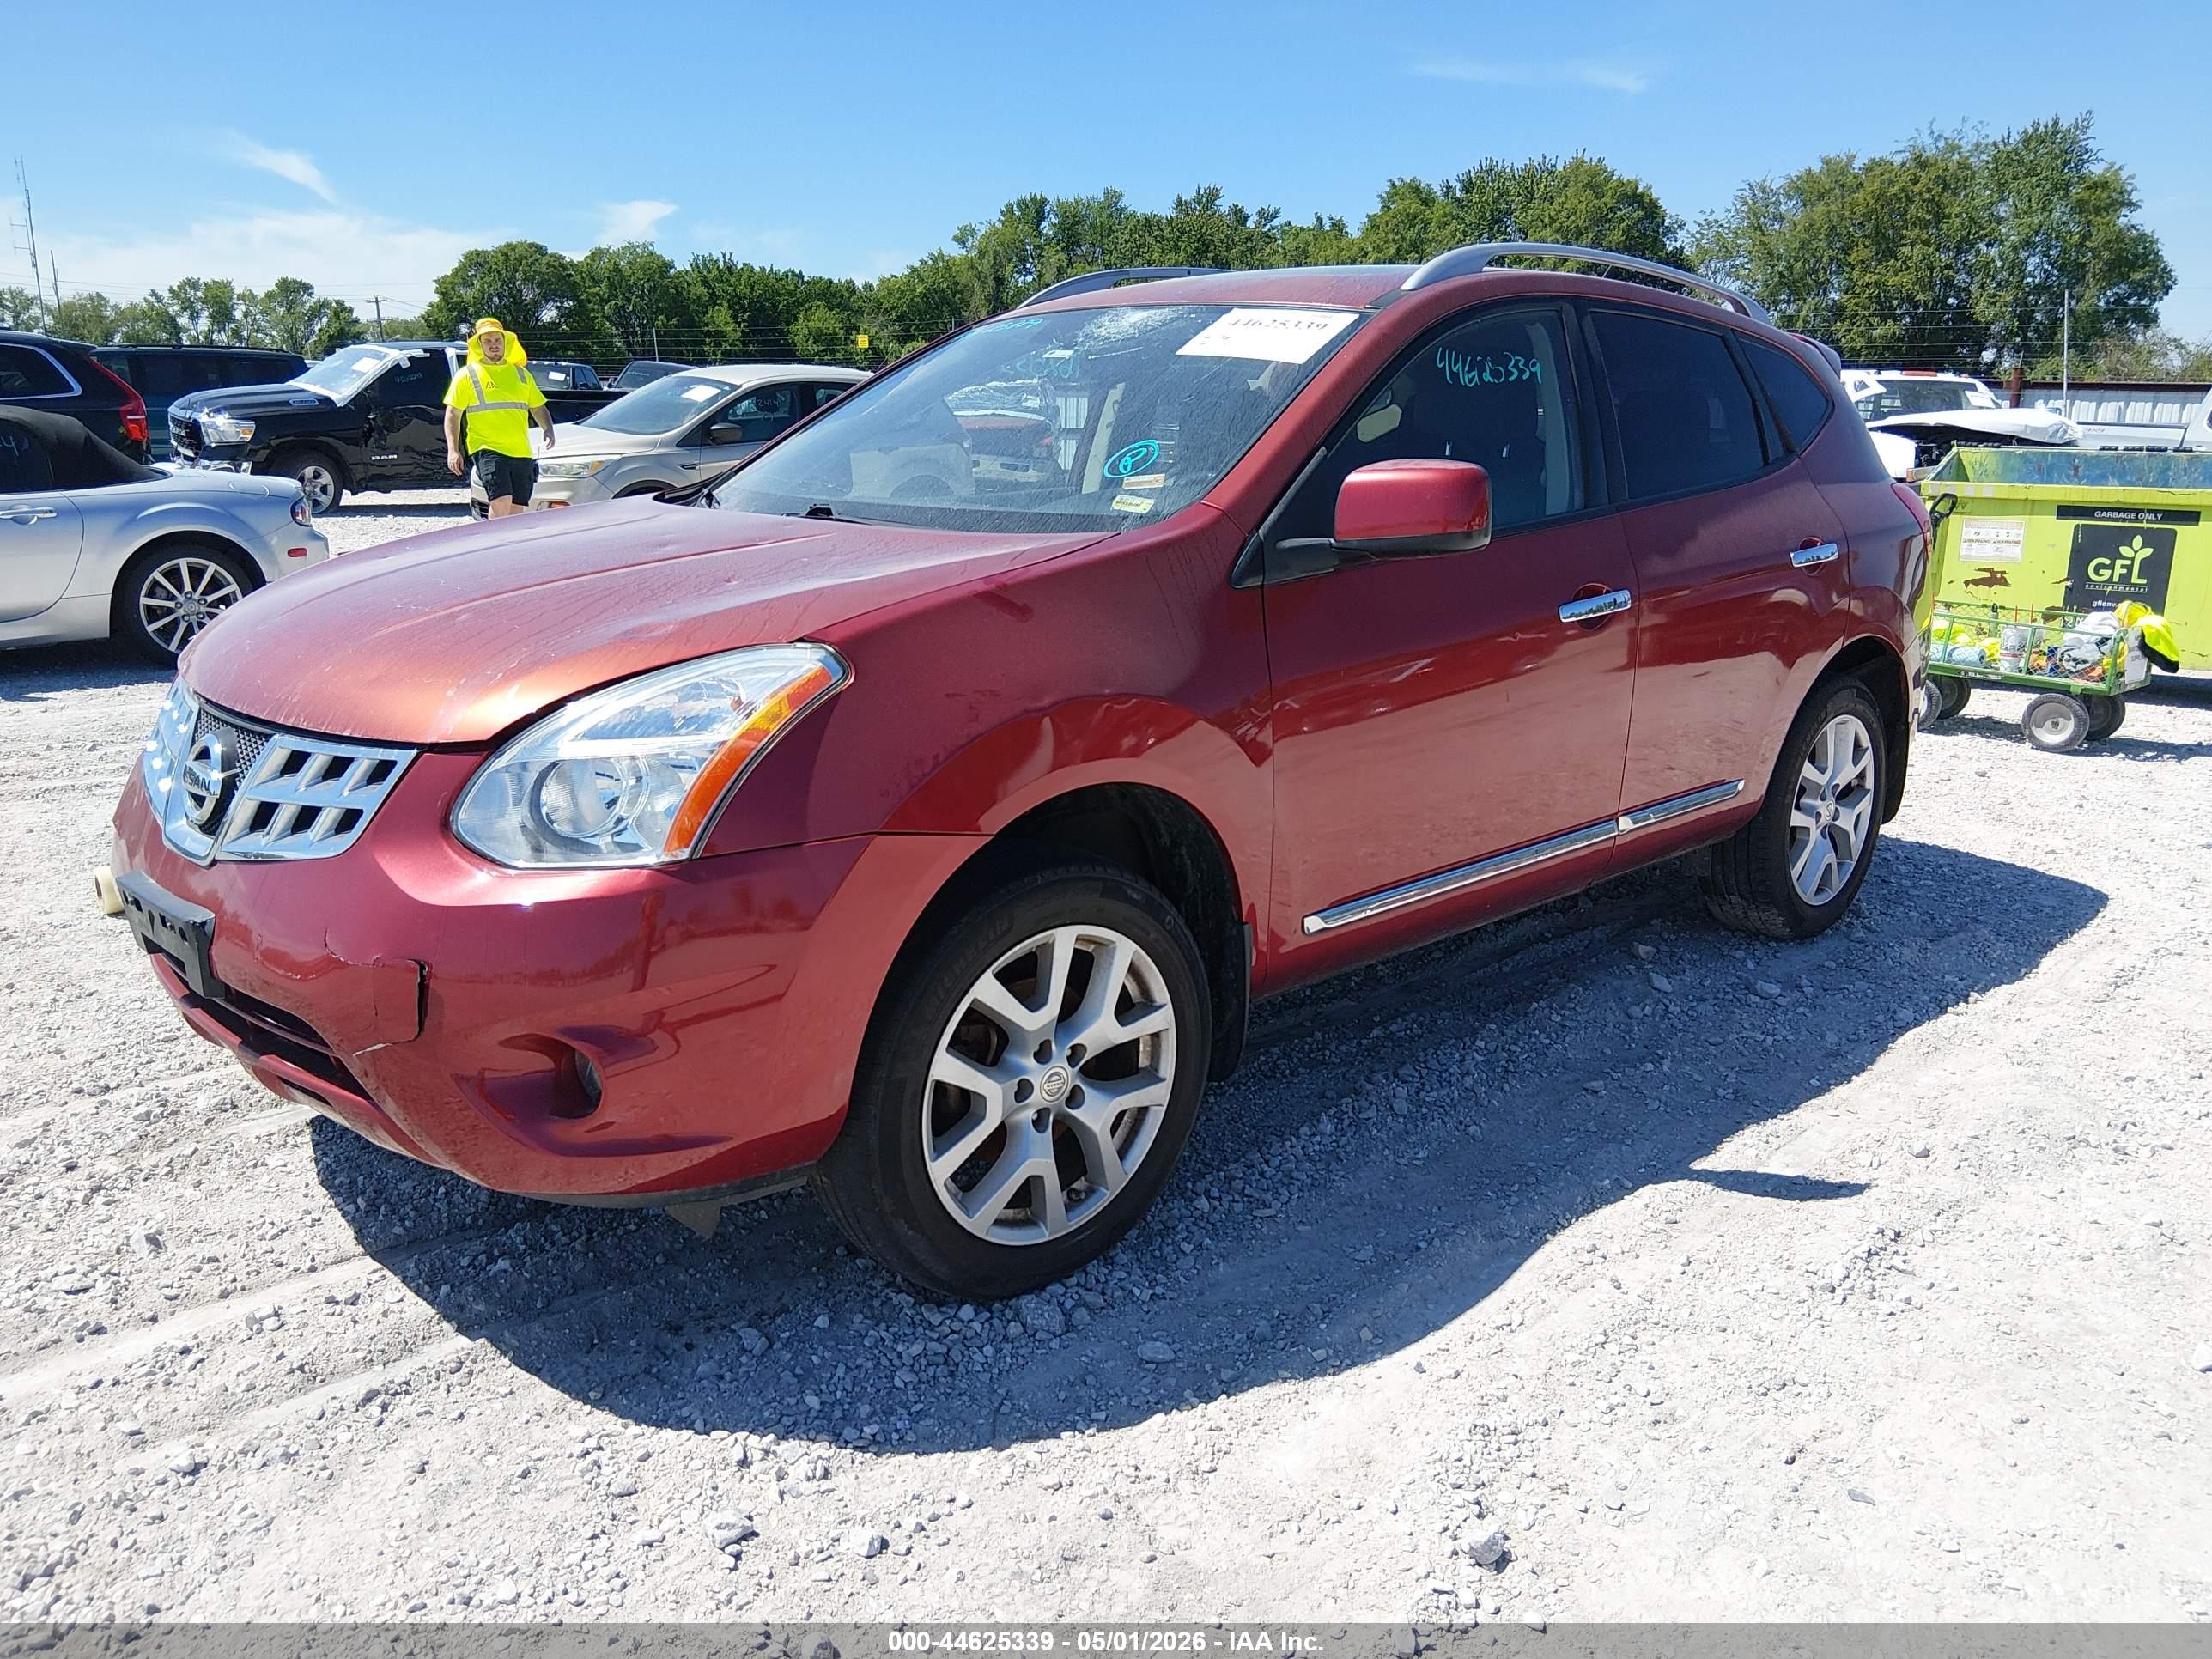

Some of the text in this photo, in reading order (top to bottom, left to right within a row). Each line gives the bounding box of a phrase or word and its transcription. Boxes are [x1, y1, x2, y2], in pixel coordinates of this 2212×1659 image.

[2094, 510, 2164, 520] GARBAGE ONLY
[2087, 548, 2150, 585] GFL
[2084, 583, 2148, 592] environmental
